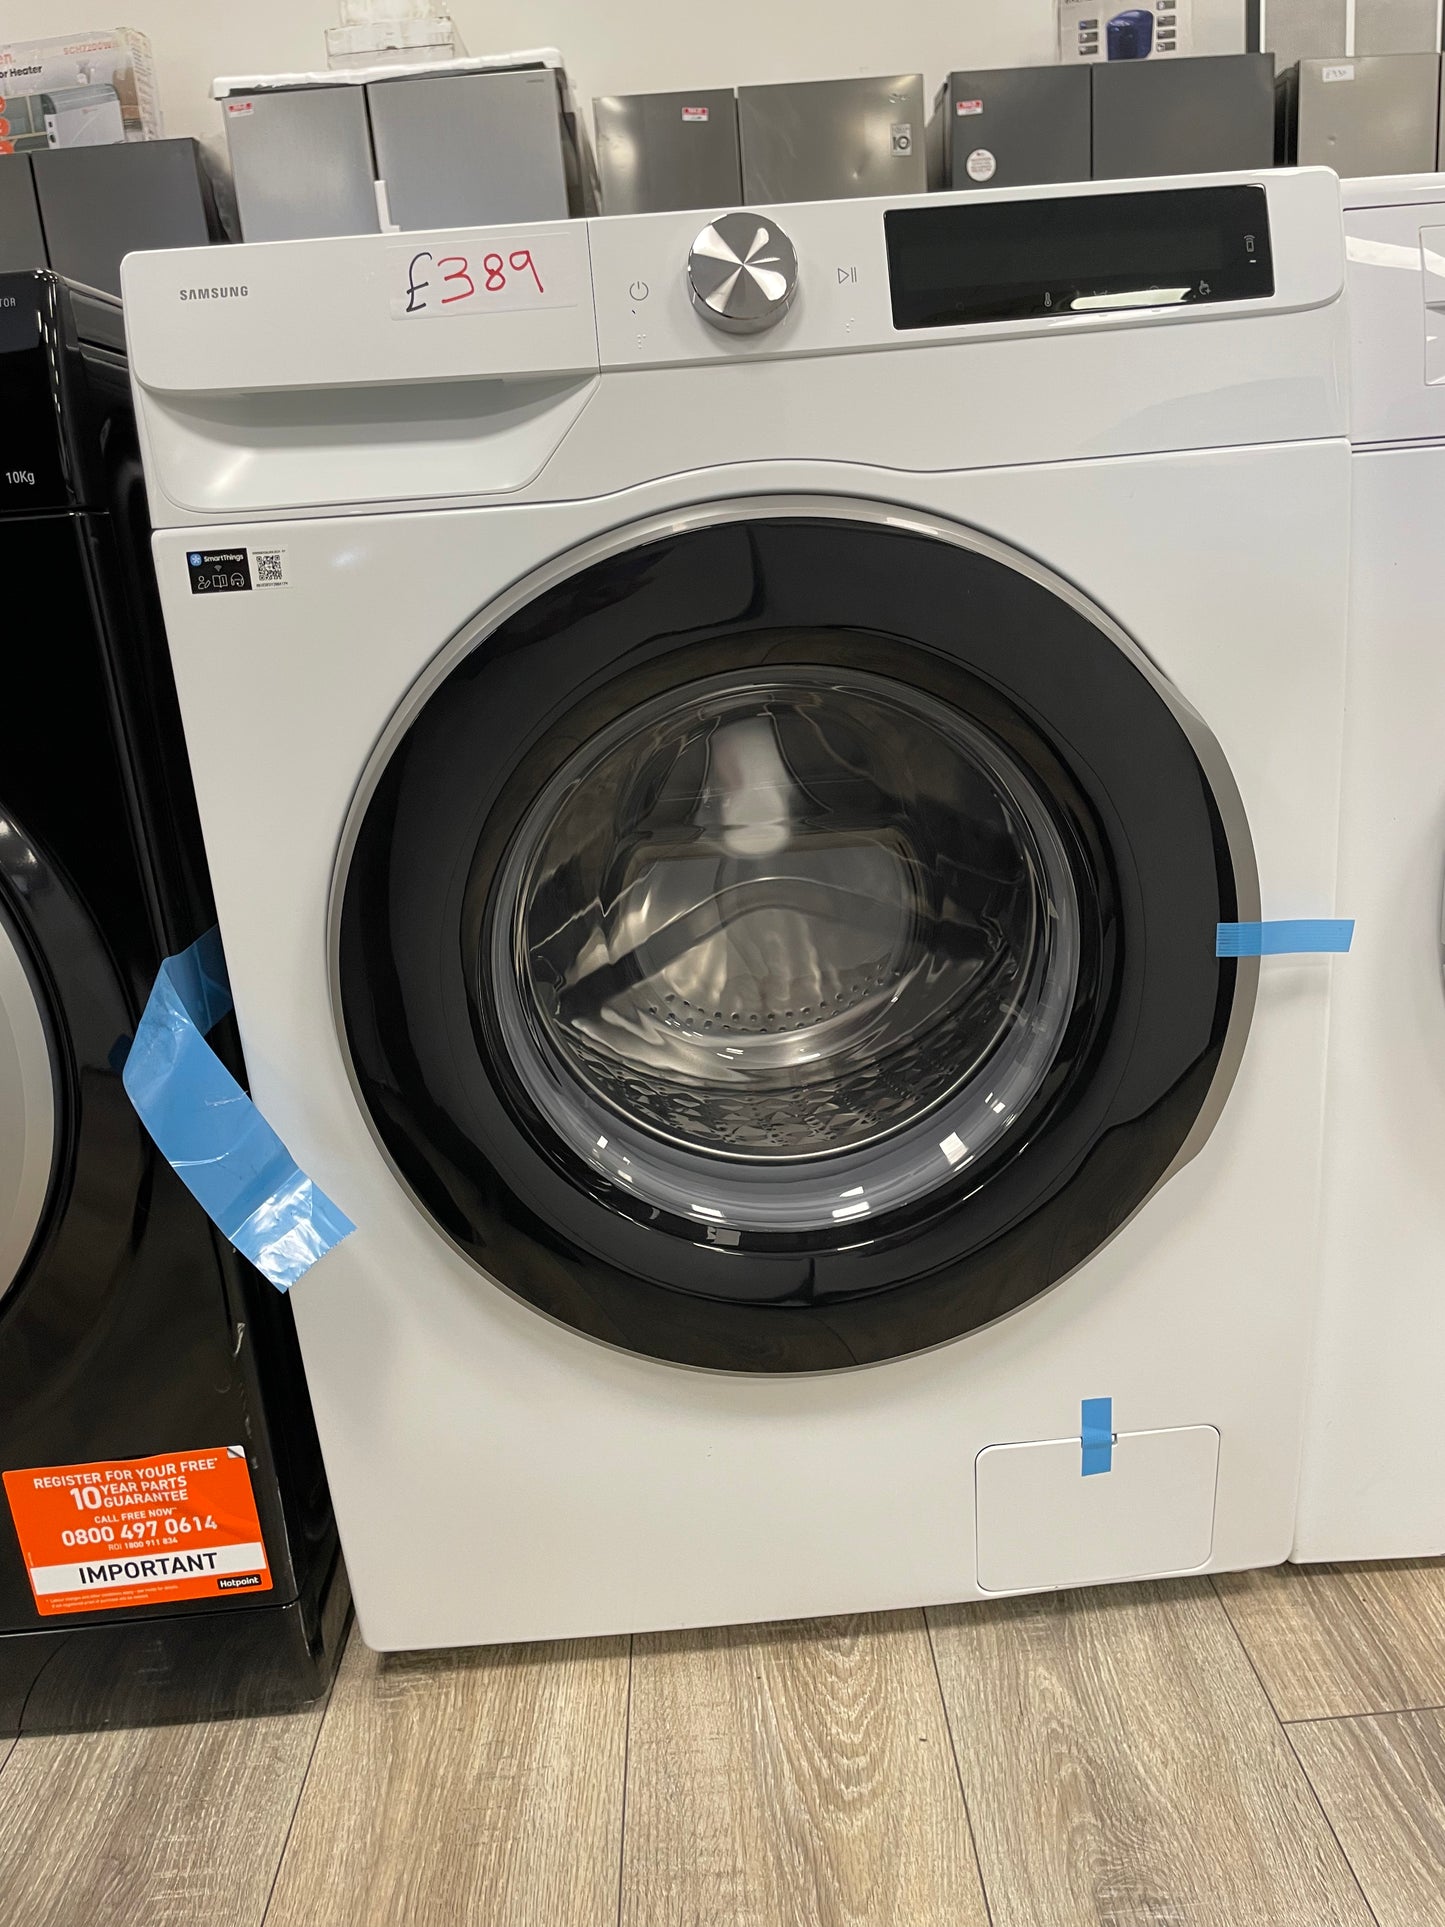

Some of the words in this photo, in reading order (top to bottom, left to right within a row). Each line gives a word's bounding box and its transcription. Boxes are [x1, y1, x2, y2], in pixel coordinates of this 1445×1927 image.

[10, 65, 43, 77] Heater
[406, 249, 544, 312] £389
[179, 285, 249, 301] SAMSUNG
[5, 470, 35, 485] 10Kg
[203, 554, 244, 563] SmartThings
[33, 1472, 102, 1489] REGISTER
[105, 1469, 133, 1482] FOR
[135, 1463, 177, 1480] YOUR
[69, 1486, 102, 1511] 10
[100, 1482, 142, 1496] YEAR
[142, 1475, 188, 1492] PARTS
[103, 1488, 189, 1508] GUARANTEE
[94, 1514, 119, 1524] CALL
[121, 1510, 146, 1520] FREE
[61, 1526, 115, 1547] 0800
[120, 1520, 158, 1540] 497
[165, 1515, 218, 1535] 0614
[108, 1543, 123, 1551] ROI
[124, 1541, 144, 1550] 1800
[145, 1539, 161, 1548] 911
[78, 1552, 218, 1584] IMPORTANT
[219, 1576, 259, 1589] Hotpoint
